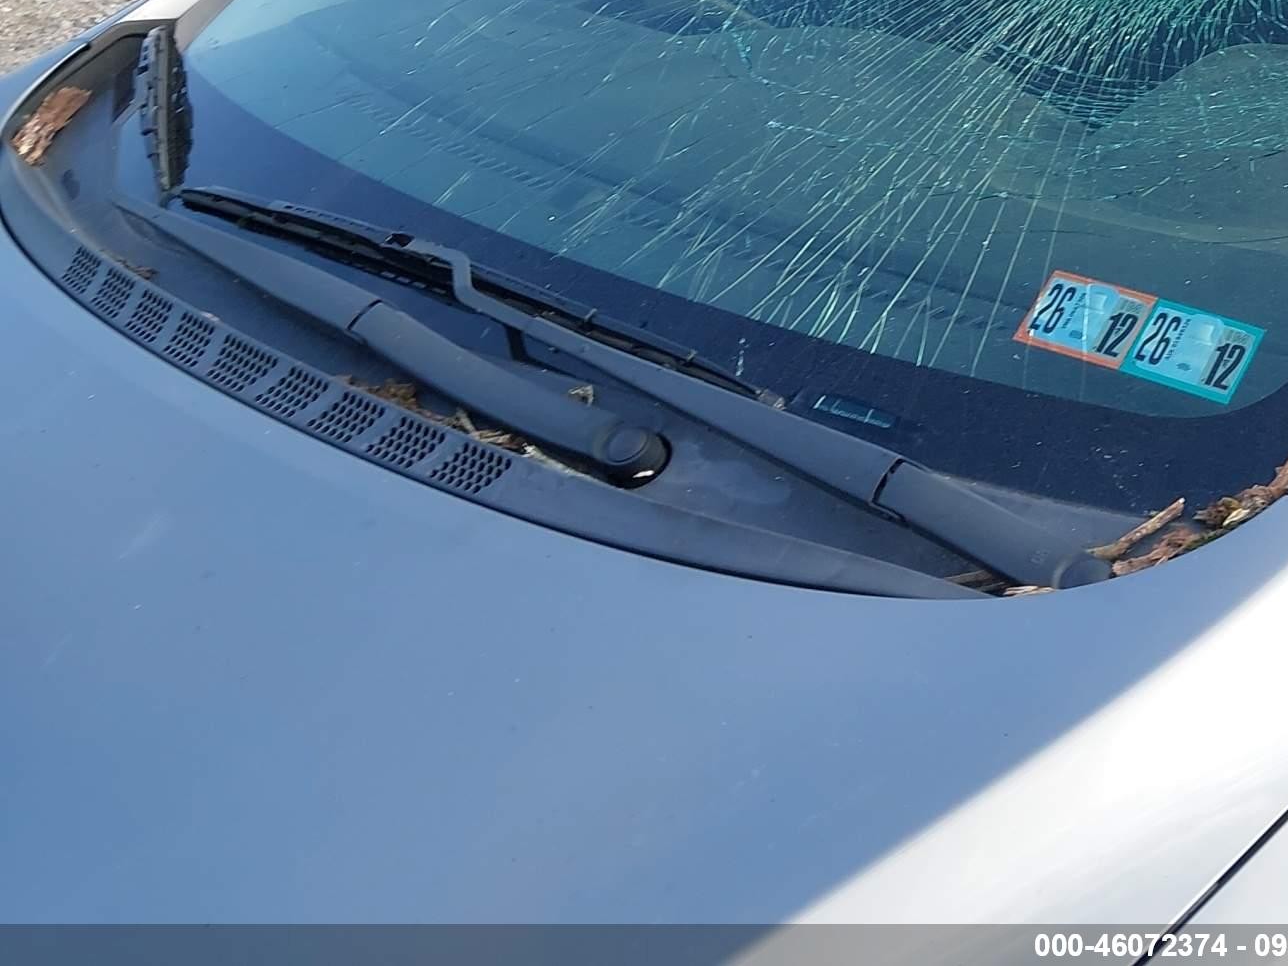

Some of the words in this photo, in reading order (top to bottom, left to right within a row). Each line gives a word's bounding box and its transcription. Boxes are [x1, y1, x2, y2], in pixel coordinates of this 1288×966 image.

[1029, 283, 1077, 333] 26
[1096, 312, 1138, 357] 12
[1134, 312, 1181, 365] 26
[1204, 342, 1246, 390] 12
